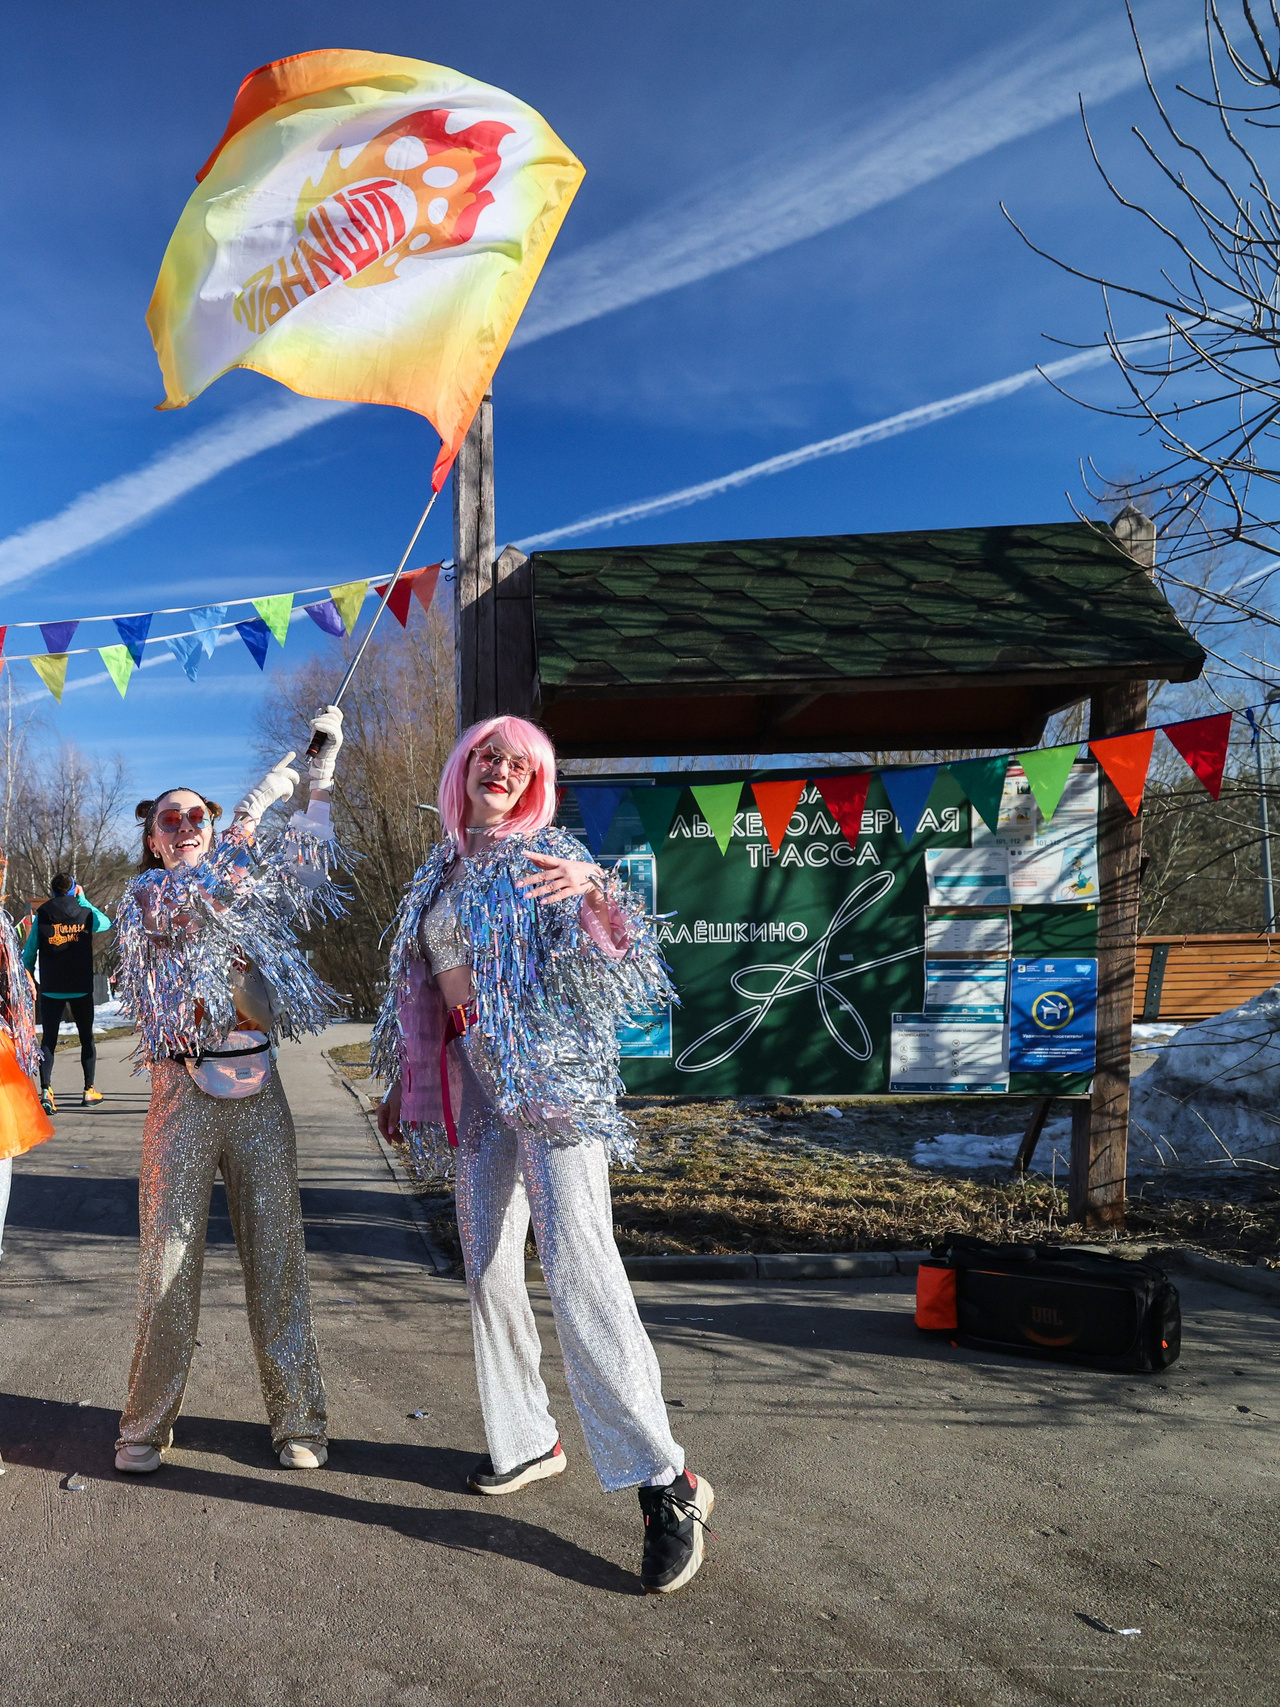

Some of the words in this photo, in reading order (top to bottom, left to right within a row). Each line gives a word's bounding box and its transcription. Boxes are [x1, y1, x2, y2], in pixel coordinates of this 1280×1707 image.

[746, 841, 881, 868] ТРАССА
[657, 920, 808, 943] АЛЁШКИНО
[1031, 1305, 1064, 1326] JBL
